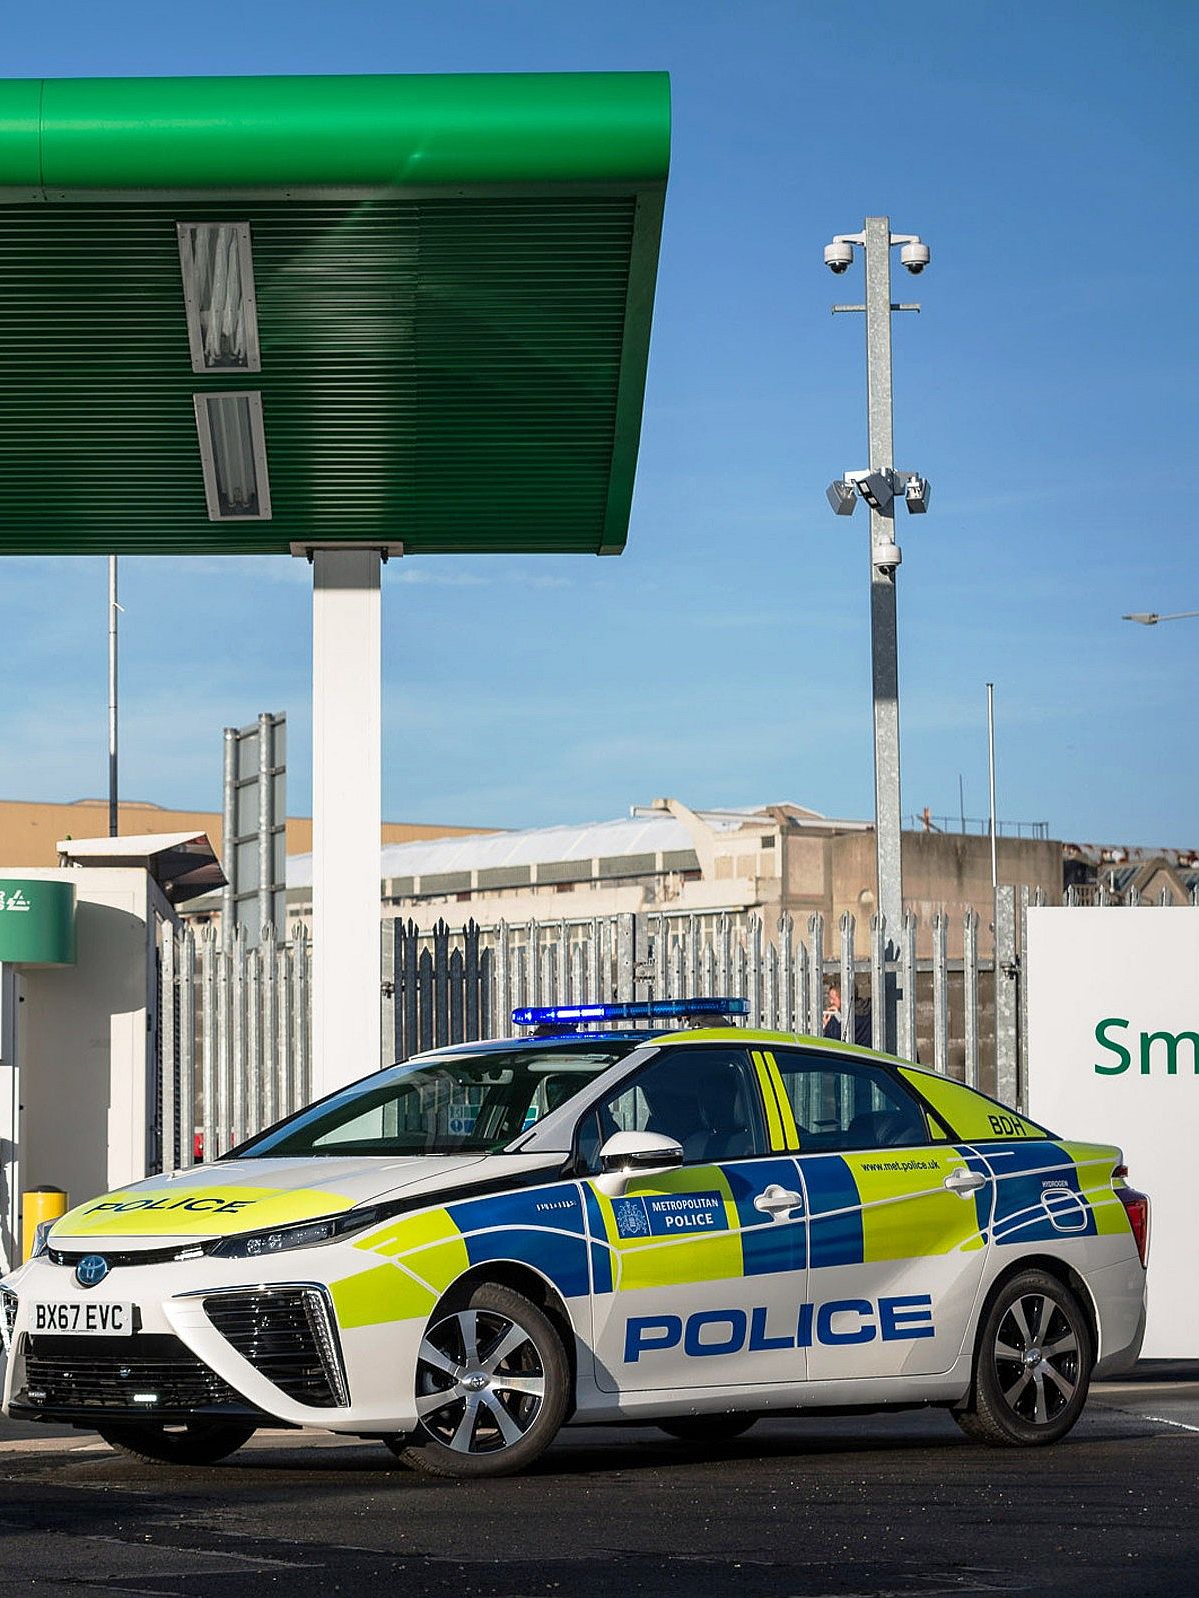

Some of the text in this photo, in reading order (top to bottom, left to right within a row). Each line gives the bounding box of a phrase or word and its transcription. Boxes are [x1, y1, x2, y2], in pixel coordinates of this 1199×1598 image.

[1094, 1017, 1199, 1075] Sm
[988, 1115, 1027, 1136] BDH
[861, 1160, 941, 1173] www.met.police.uk
[1041, 1180, 1069, 1188] HYDROGEN
[83, 1197, 257, 1215] POLICE
[652, 1198, 719, 1212] METROPOLITAN
[665, 1213, 714, 1228] POLICE
[36, 1304, 123, 1330] BX67 EVC
[624, 1294, 935, 1363] POLICE
